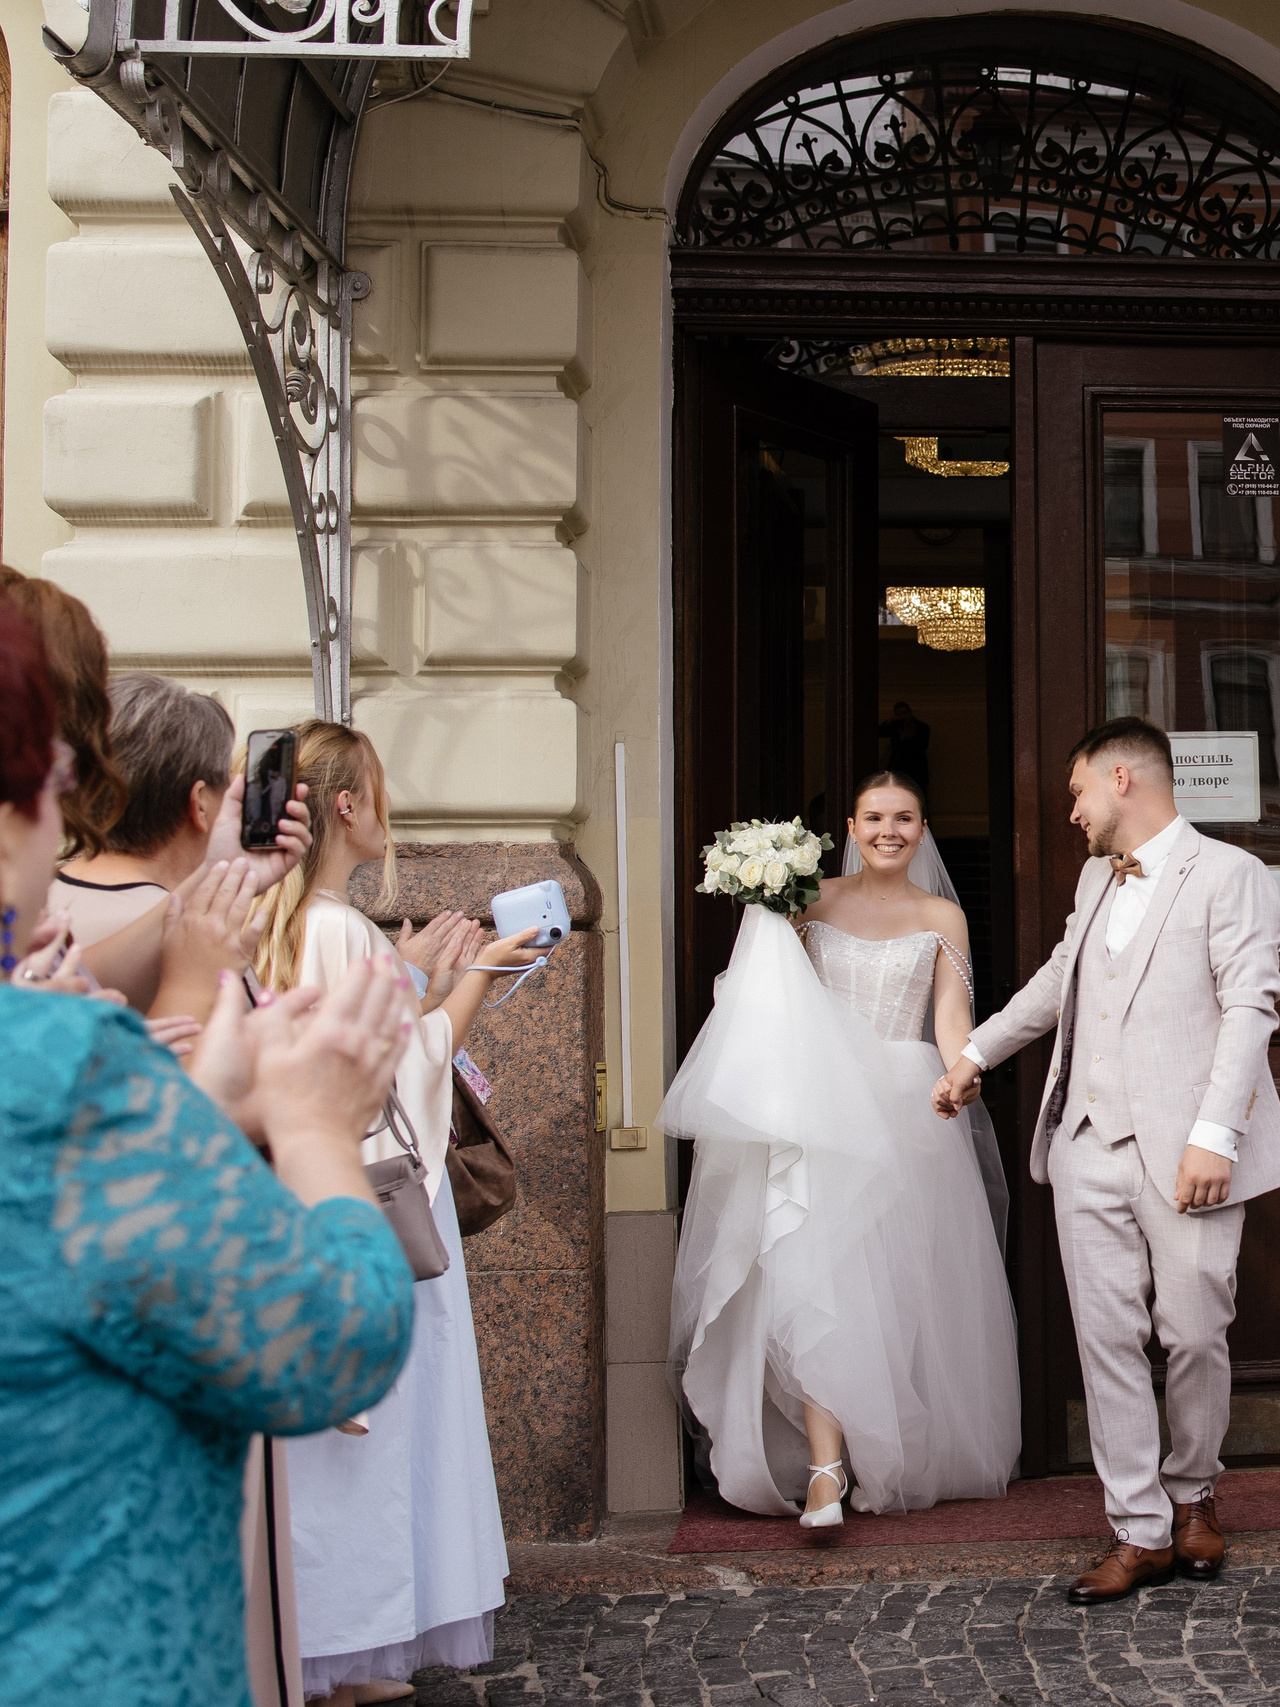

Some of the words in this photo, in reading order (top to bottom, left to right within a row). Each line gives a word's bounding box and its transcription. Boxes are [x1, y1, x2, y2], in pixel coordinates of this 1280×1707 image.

[1229, 463, 1275, 472] ALPHA
[1229, 471, 1275, 480] SECTOR
[1173, 754, 1233, 765] постиль
[1189, 776, 1230, 789] дворе
